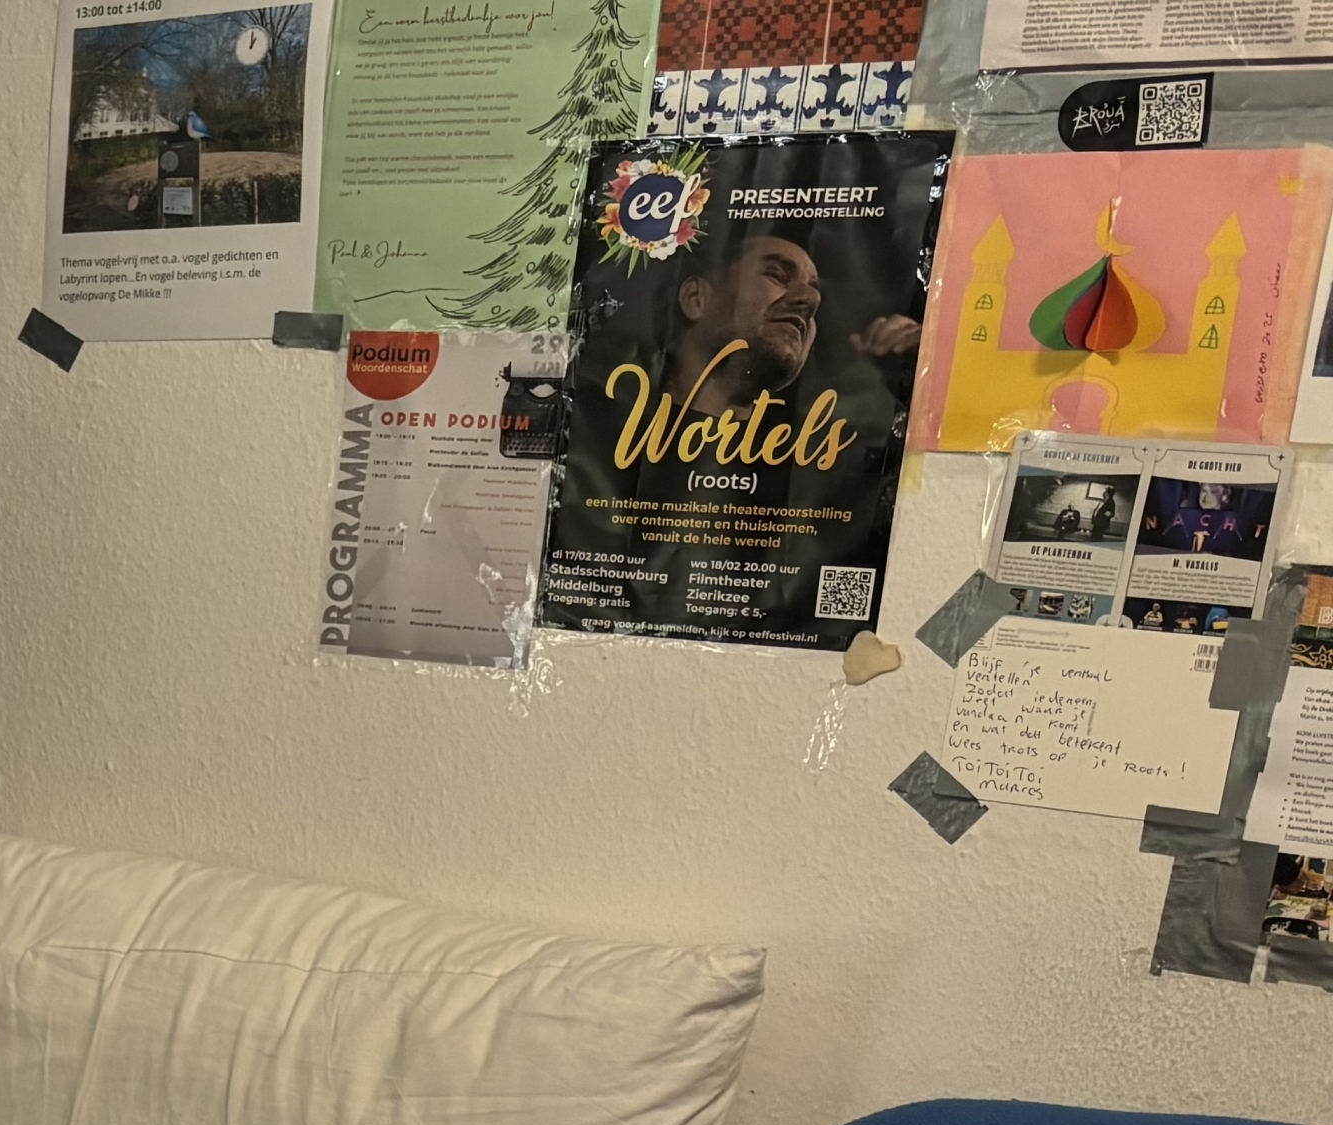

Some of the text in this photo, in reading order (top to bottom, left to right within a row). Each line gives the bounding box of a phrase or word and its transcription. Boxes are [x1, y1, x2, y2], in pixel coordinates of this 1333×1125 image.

[76, 6, 103, 20] 13:00
[106, 4, 124, 16] tot
[628, 173, 702, 234] eef
[729, 186, 879, 206] PRESENTEERT
[727, 206, 885, 220] THEATERVOORSTELLING
[60, 249, 279, 271] Thema vogel-vrij met o.a. vogel gedichten en
[60, 272, 97, 287] Labyrint
[149, 269, 175, 282] vogel
[177, 268, 218, 282] beleving
[220, 268, 246, 279] i.s.m.
[248, 266, 261, 278] de
[59, 288, 172, 303] vogelopvang De Mikke !!!
[351, 344, 431, 364] Podium
[351, 362, 428, 375] Woordenschat
[605, 339, 858, 471] Wortels
[381, 412, 532, 431] OPEN PODIUM
[686, 471, 759, 494] (roots)
[585, 497, 853, 522] een intieme muzikale theatervoorstelling
[319, 403, 374, 647] PROGRAMMA
[611, 514, 819, 536] over ontmoeten en thuiskomen,
[641, 531, 781, 549] vanuit de hele wereld
[552, 549, 647, 565] di 17/02 20.00 uur
[1184, 559, 1219, 572] VASALIS
[549, 563, 669, 585] Stadsschouwburg
[690, 558, 801, 576] wo 18/02 20.00 uur
[548, 579, 624, 596] Middelburg
[688, 572, 771, 590] Filmtheater
[547, 592, 631, 609] Toegang: gratis
[686, 587, 750, 603] Zierikzee
[685, 603, 767, 620] Toegang: € 5,-
[581, 617, 818, 644] graag vooraf aanmelden, kijk op eeffestival.nl
